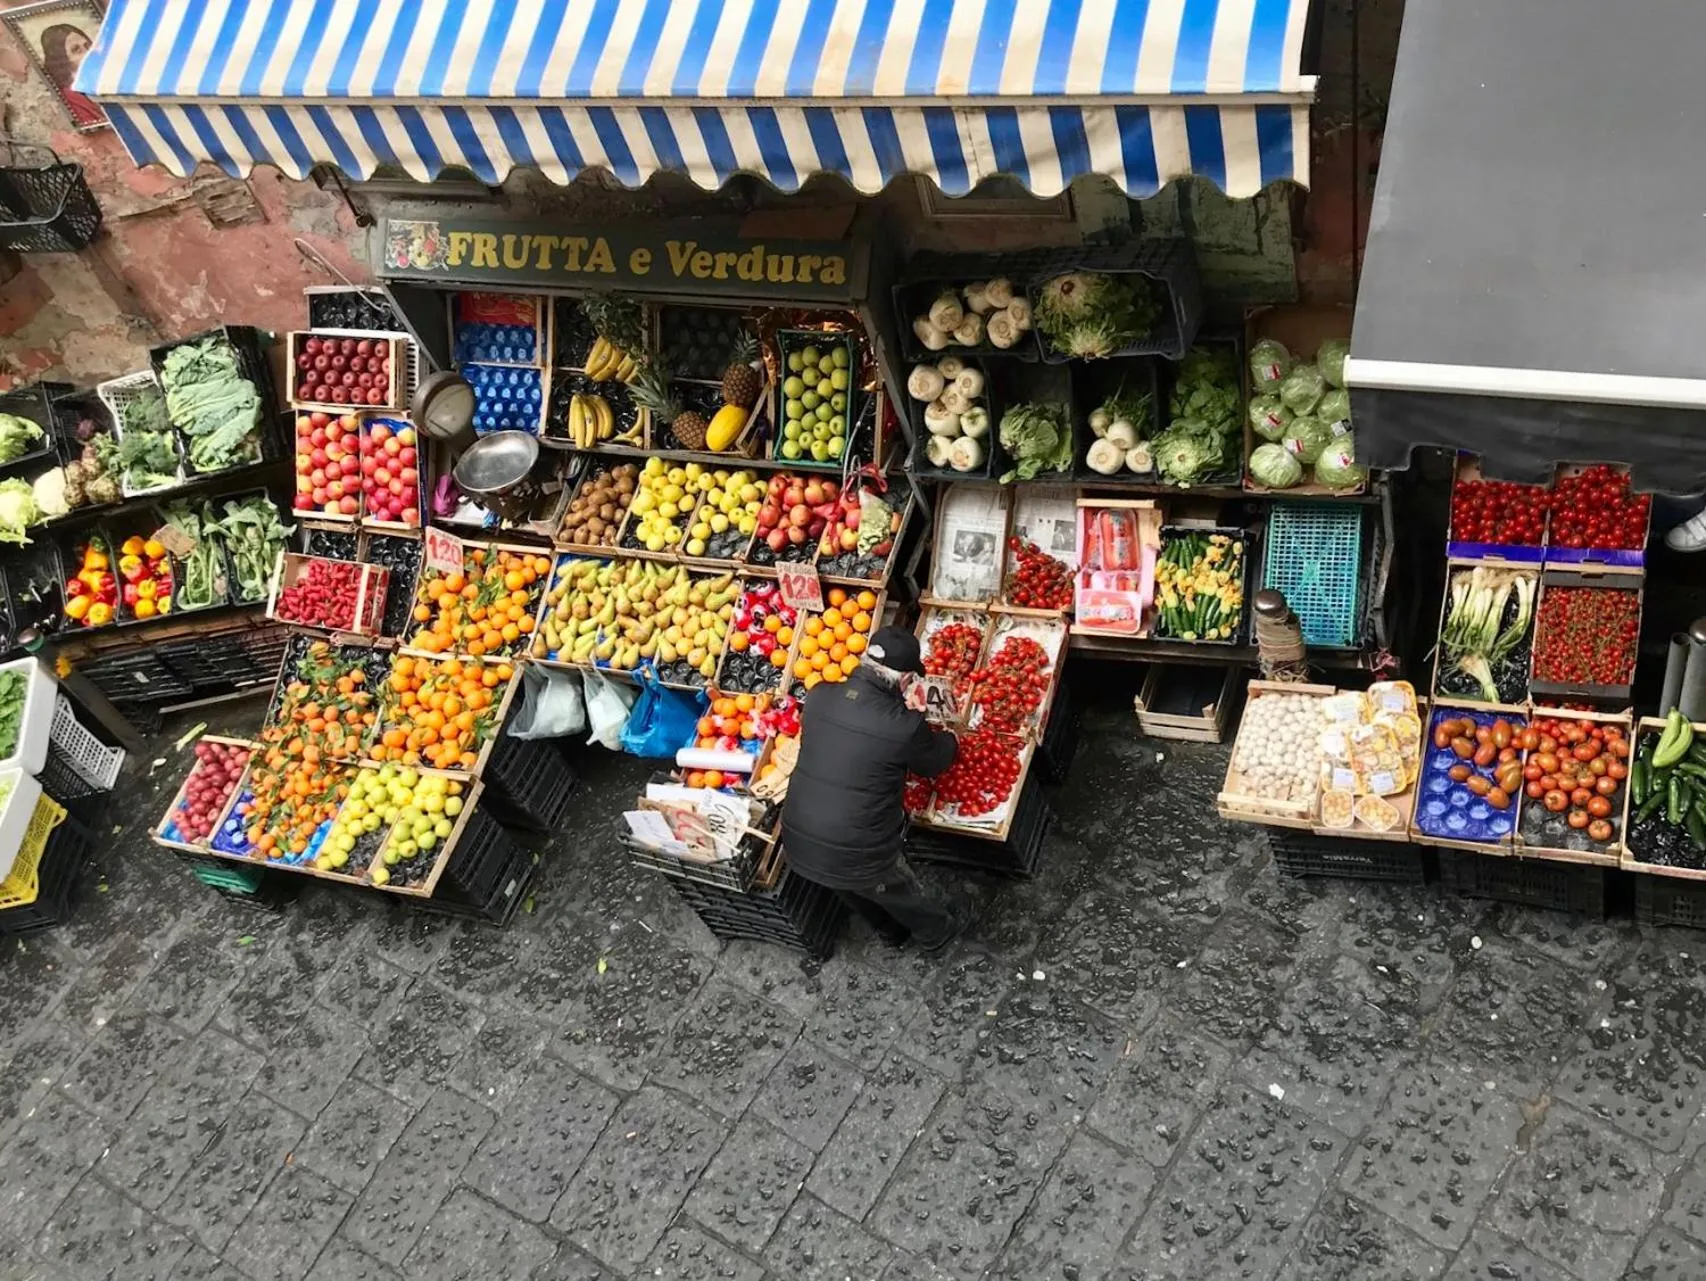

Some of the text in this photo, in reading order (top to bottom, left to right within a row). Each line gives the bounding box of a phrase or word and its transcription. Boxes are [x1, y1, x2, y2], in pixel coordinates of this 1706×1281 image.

[446, 231, 846, 285] FRUTTA e Verdura
